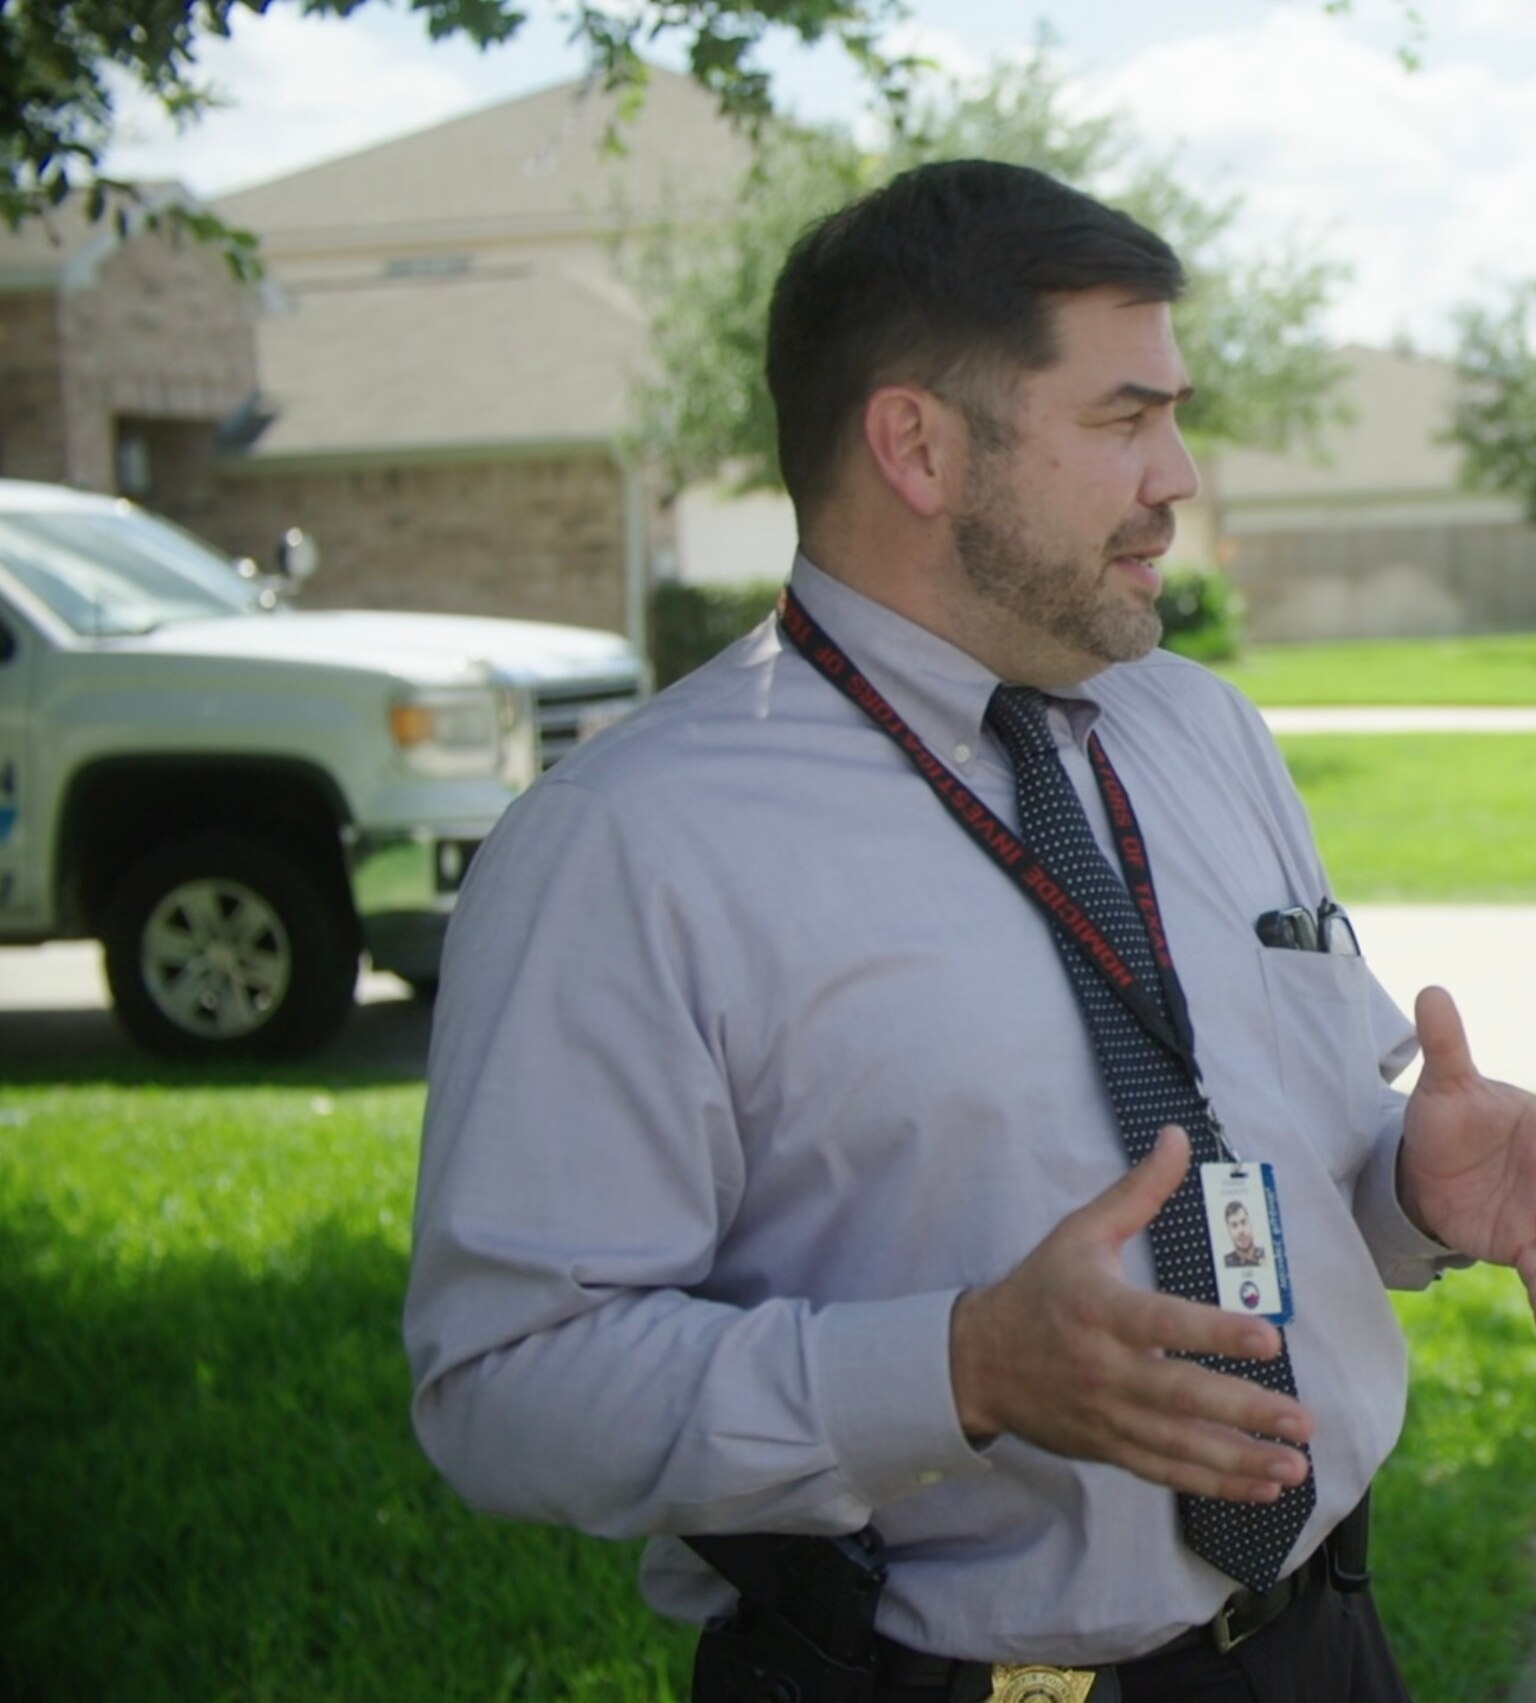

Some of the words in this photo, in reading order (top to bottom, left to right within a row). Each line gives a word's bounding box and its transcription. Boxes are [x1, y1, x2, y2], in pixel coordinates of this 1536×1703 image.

[813, 646, 843, 674] OF
[846, 677, 1025, 867] INVESTIGATORS
[1023, 866, 1134, 987] HOMICIDE
[1121, 838, 1143, 868] OF
[1134, 883, 1172, 967] TEXAS
